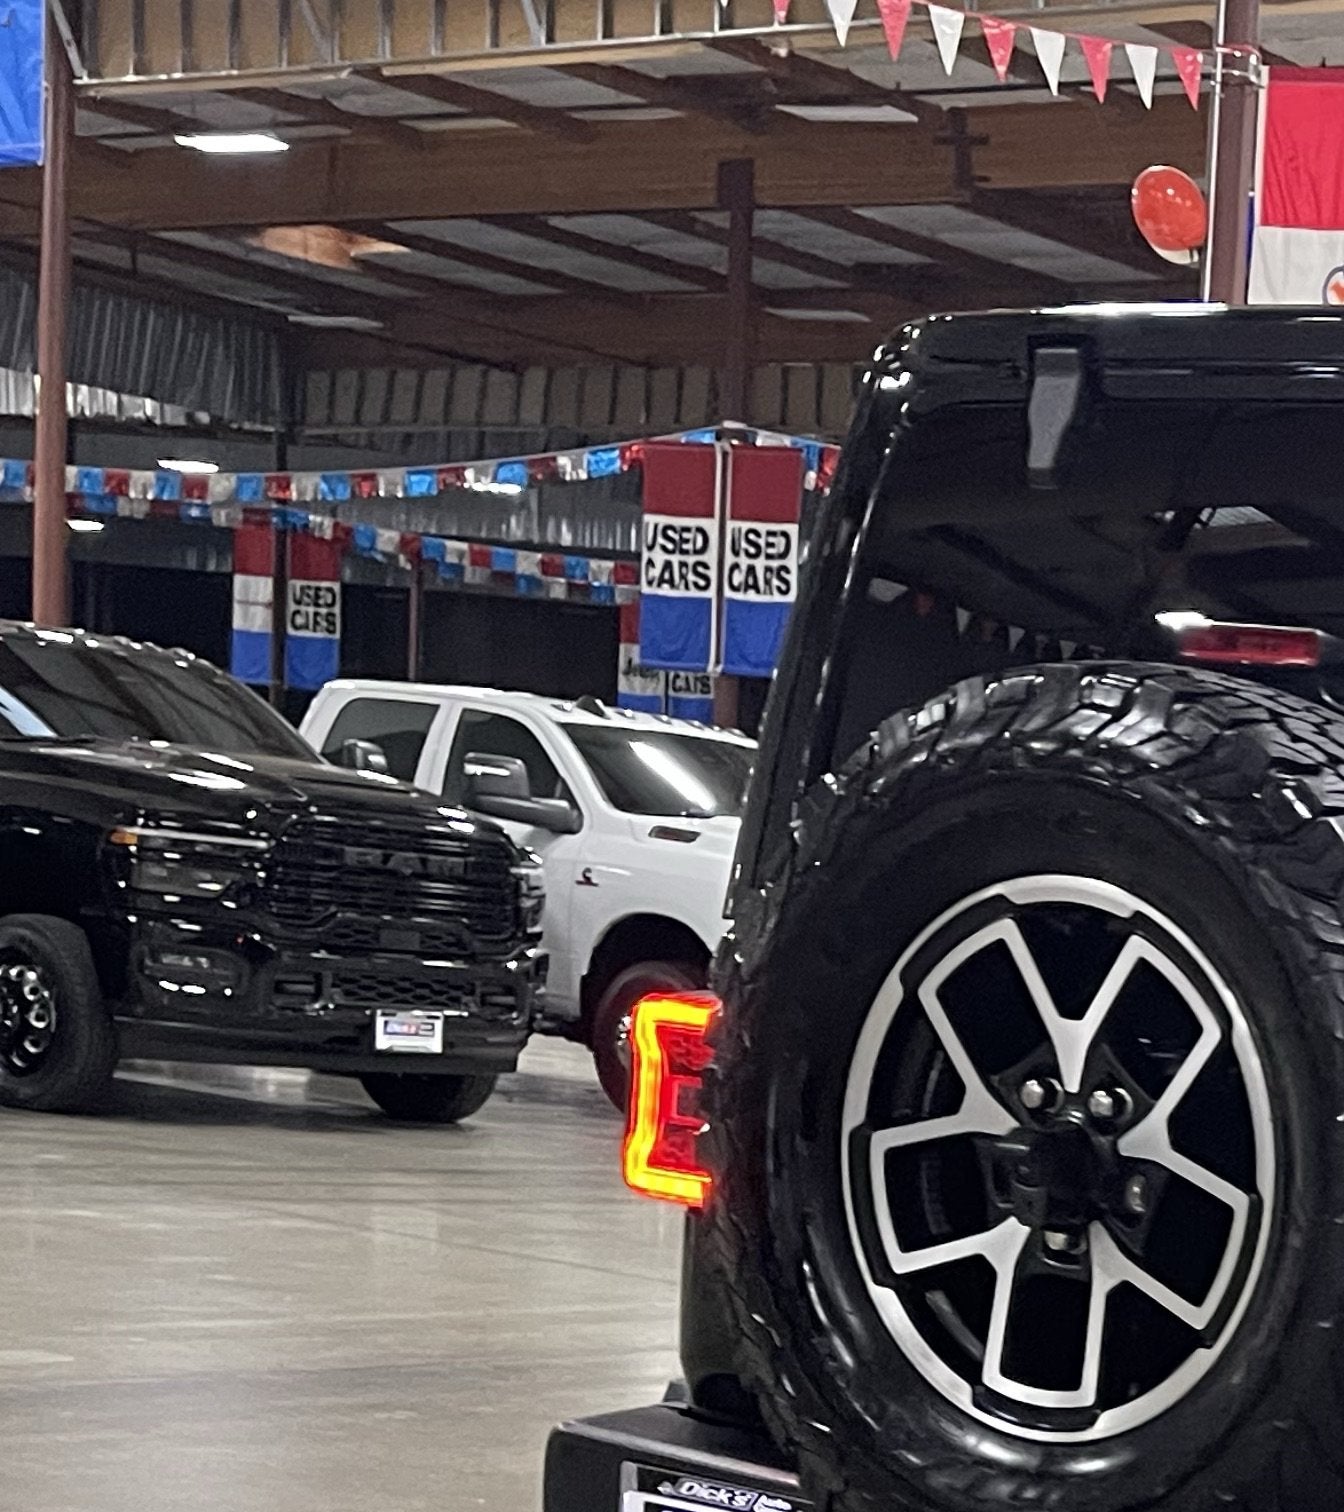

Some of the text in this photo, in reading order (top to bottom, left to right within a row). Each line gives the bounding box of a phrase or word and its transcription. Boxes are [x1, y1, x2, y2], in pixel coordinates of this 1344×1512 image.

[646, 521, 710, 556] USED
[732, 526, 791, 560] USED
[645, 557, 711, 592] CARS
[728, 562, 791, 596] CARS
[292, 584, 337, 608] USED
